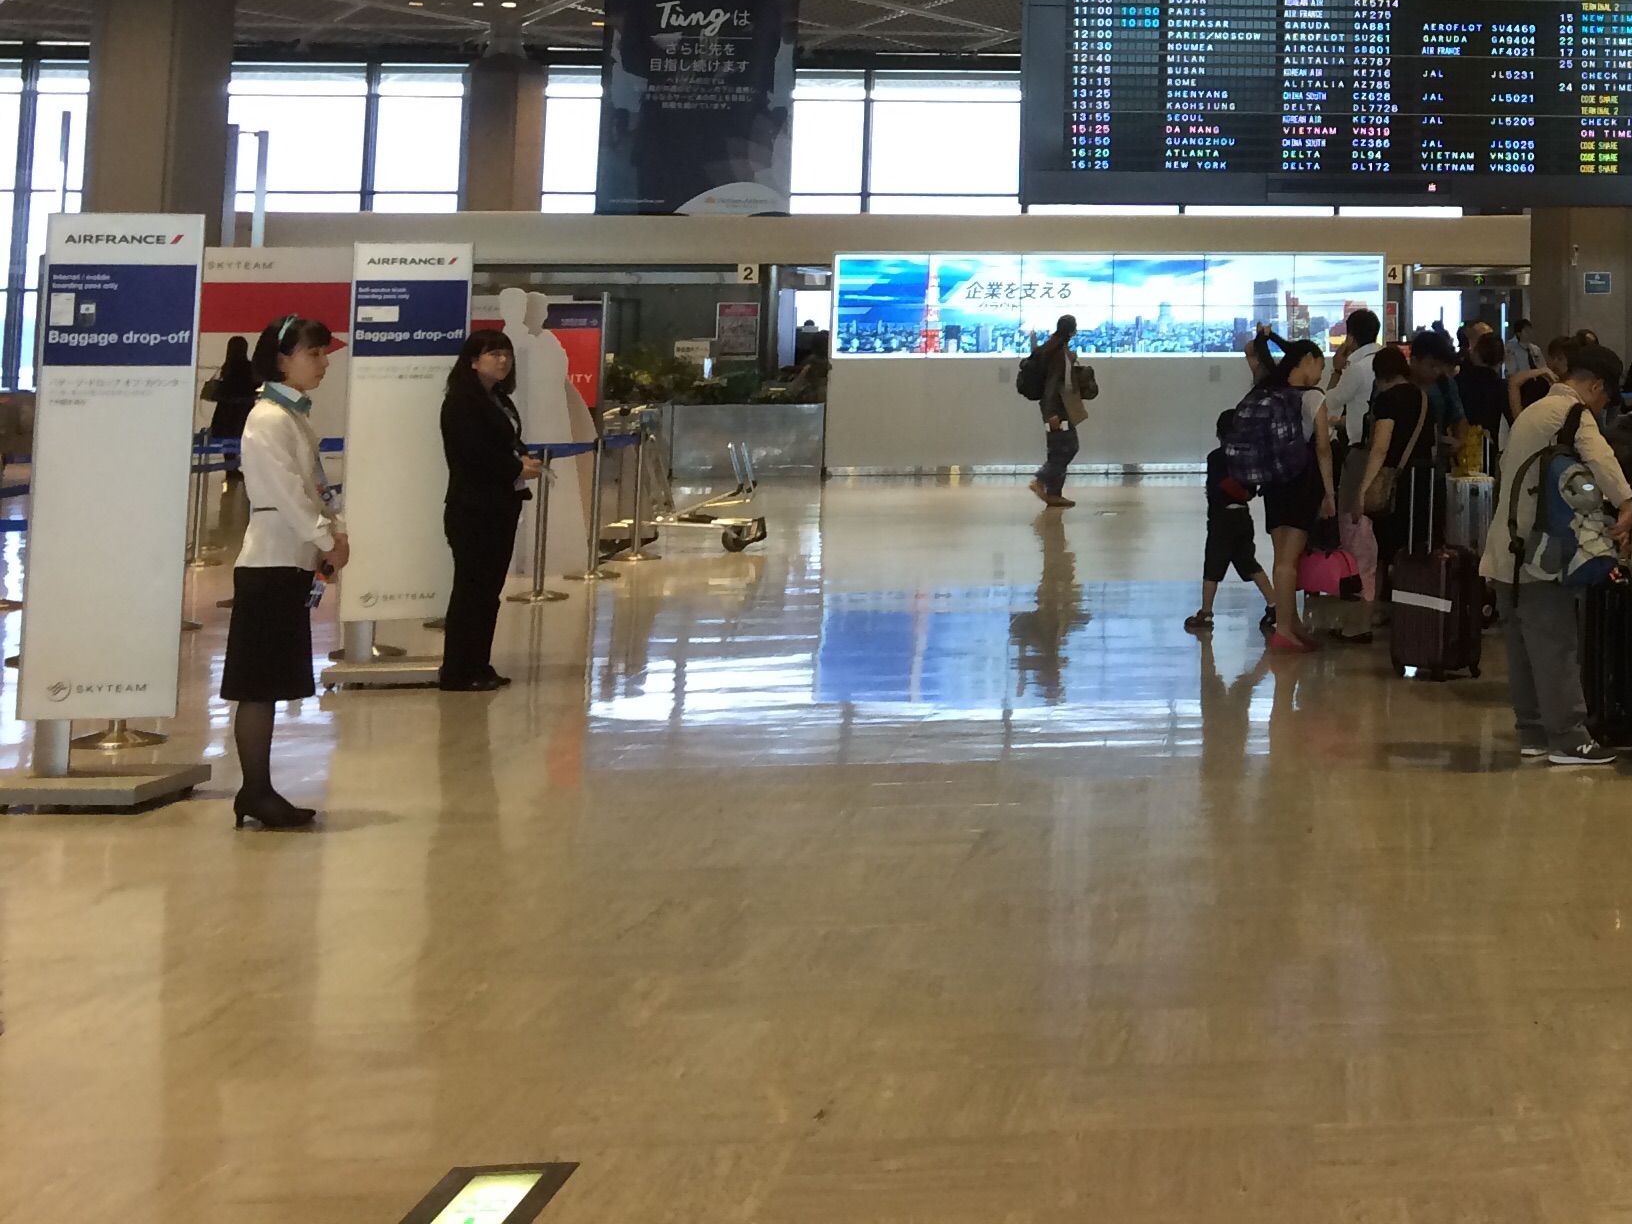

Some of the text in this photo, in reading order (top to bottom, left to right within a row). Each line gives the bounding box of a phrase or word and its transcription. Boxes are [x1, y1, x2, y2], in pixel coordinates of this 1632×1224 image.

[656, 1, 751, 36] Tùng は
[1167, 19, 1229, 28] DENPASAR
[1423, 24, 1483, 32] AEROFLOT
[1073, 30, 1345, 42] 12:00 PARIS/MOSCOW AEROFLOT
[1423, 35, 1632, 46] GARUDA 22 ON TIME
[665, 42, 736, 56] さらに先を
[1284, 45, 1345, 53] AIRCALIN
[1559, 49, 1632, 57] 17 ON TIME
[650, 57, 750, 73] 目指し続けます
[1167, 55, 1345, 65] MILAN ALITALIA
[1559, 60, 1573, 69] 25
[1581, 72, 1618, 80] CHECK
[1167, 78, 1345, 88] ROME ALITALIA
[1559, 83, 1573, 92] 24
[1167, 90, 1228, 99] SHENYANG
[1166, 102, 1236, 111] KAOHSIUNG
[1166, 126, 1337, 135] DA NANG VIETNAM
[1166, 149, 1219, 158] ATLANTA
[1352, 151, 1382, 159] DL94
[1421, 152, 1474, 160] VIETNAM
[1165, 161, 1390, 171] NEW YORK DELTA DL172
[64, 234, 167, 245] AIRFRANCE
[366, 256, 446, 266] AIRFRANCE
[743, 267, 754, 281] 2
[1387, 266, 1398, 281] 4
[966, 281, 1072, 299] 企業を支える
[48, 330, 190, 346] Baggage drop-off
[355, 329, 464, 342] Baggage drop-off
[76, 683, 148, 694] SKYTEAM
